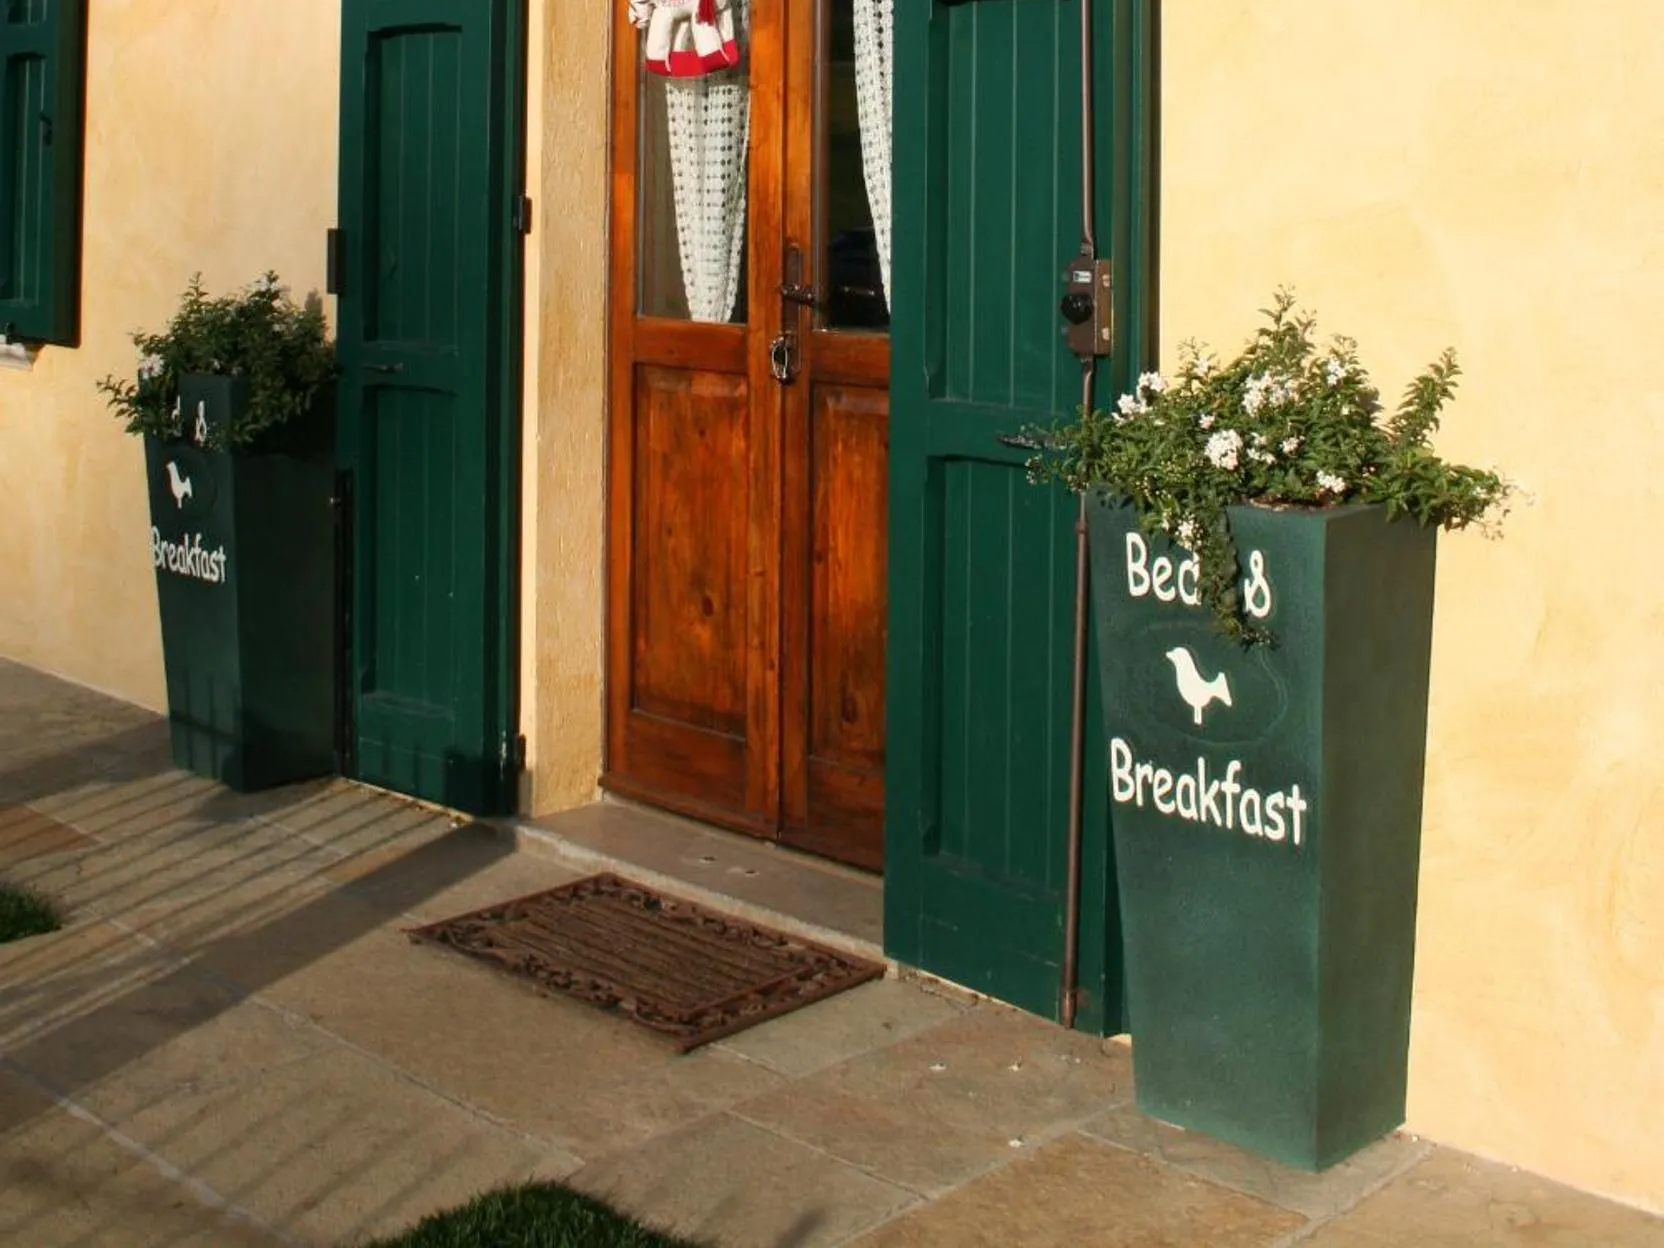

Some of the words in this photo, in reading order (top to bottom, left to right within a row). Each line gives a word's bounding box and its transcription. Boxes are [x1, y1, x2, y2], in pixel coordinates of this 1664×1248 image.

[151, 525, 226, 584] Breakfast
[1244, 550, 1271, 618] &
[1111, 737, 1307, 845] Breakfast
